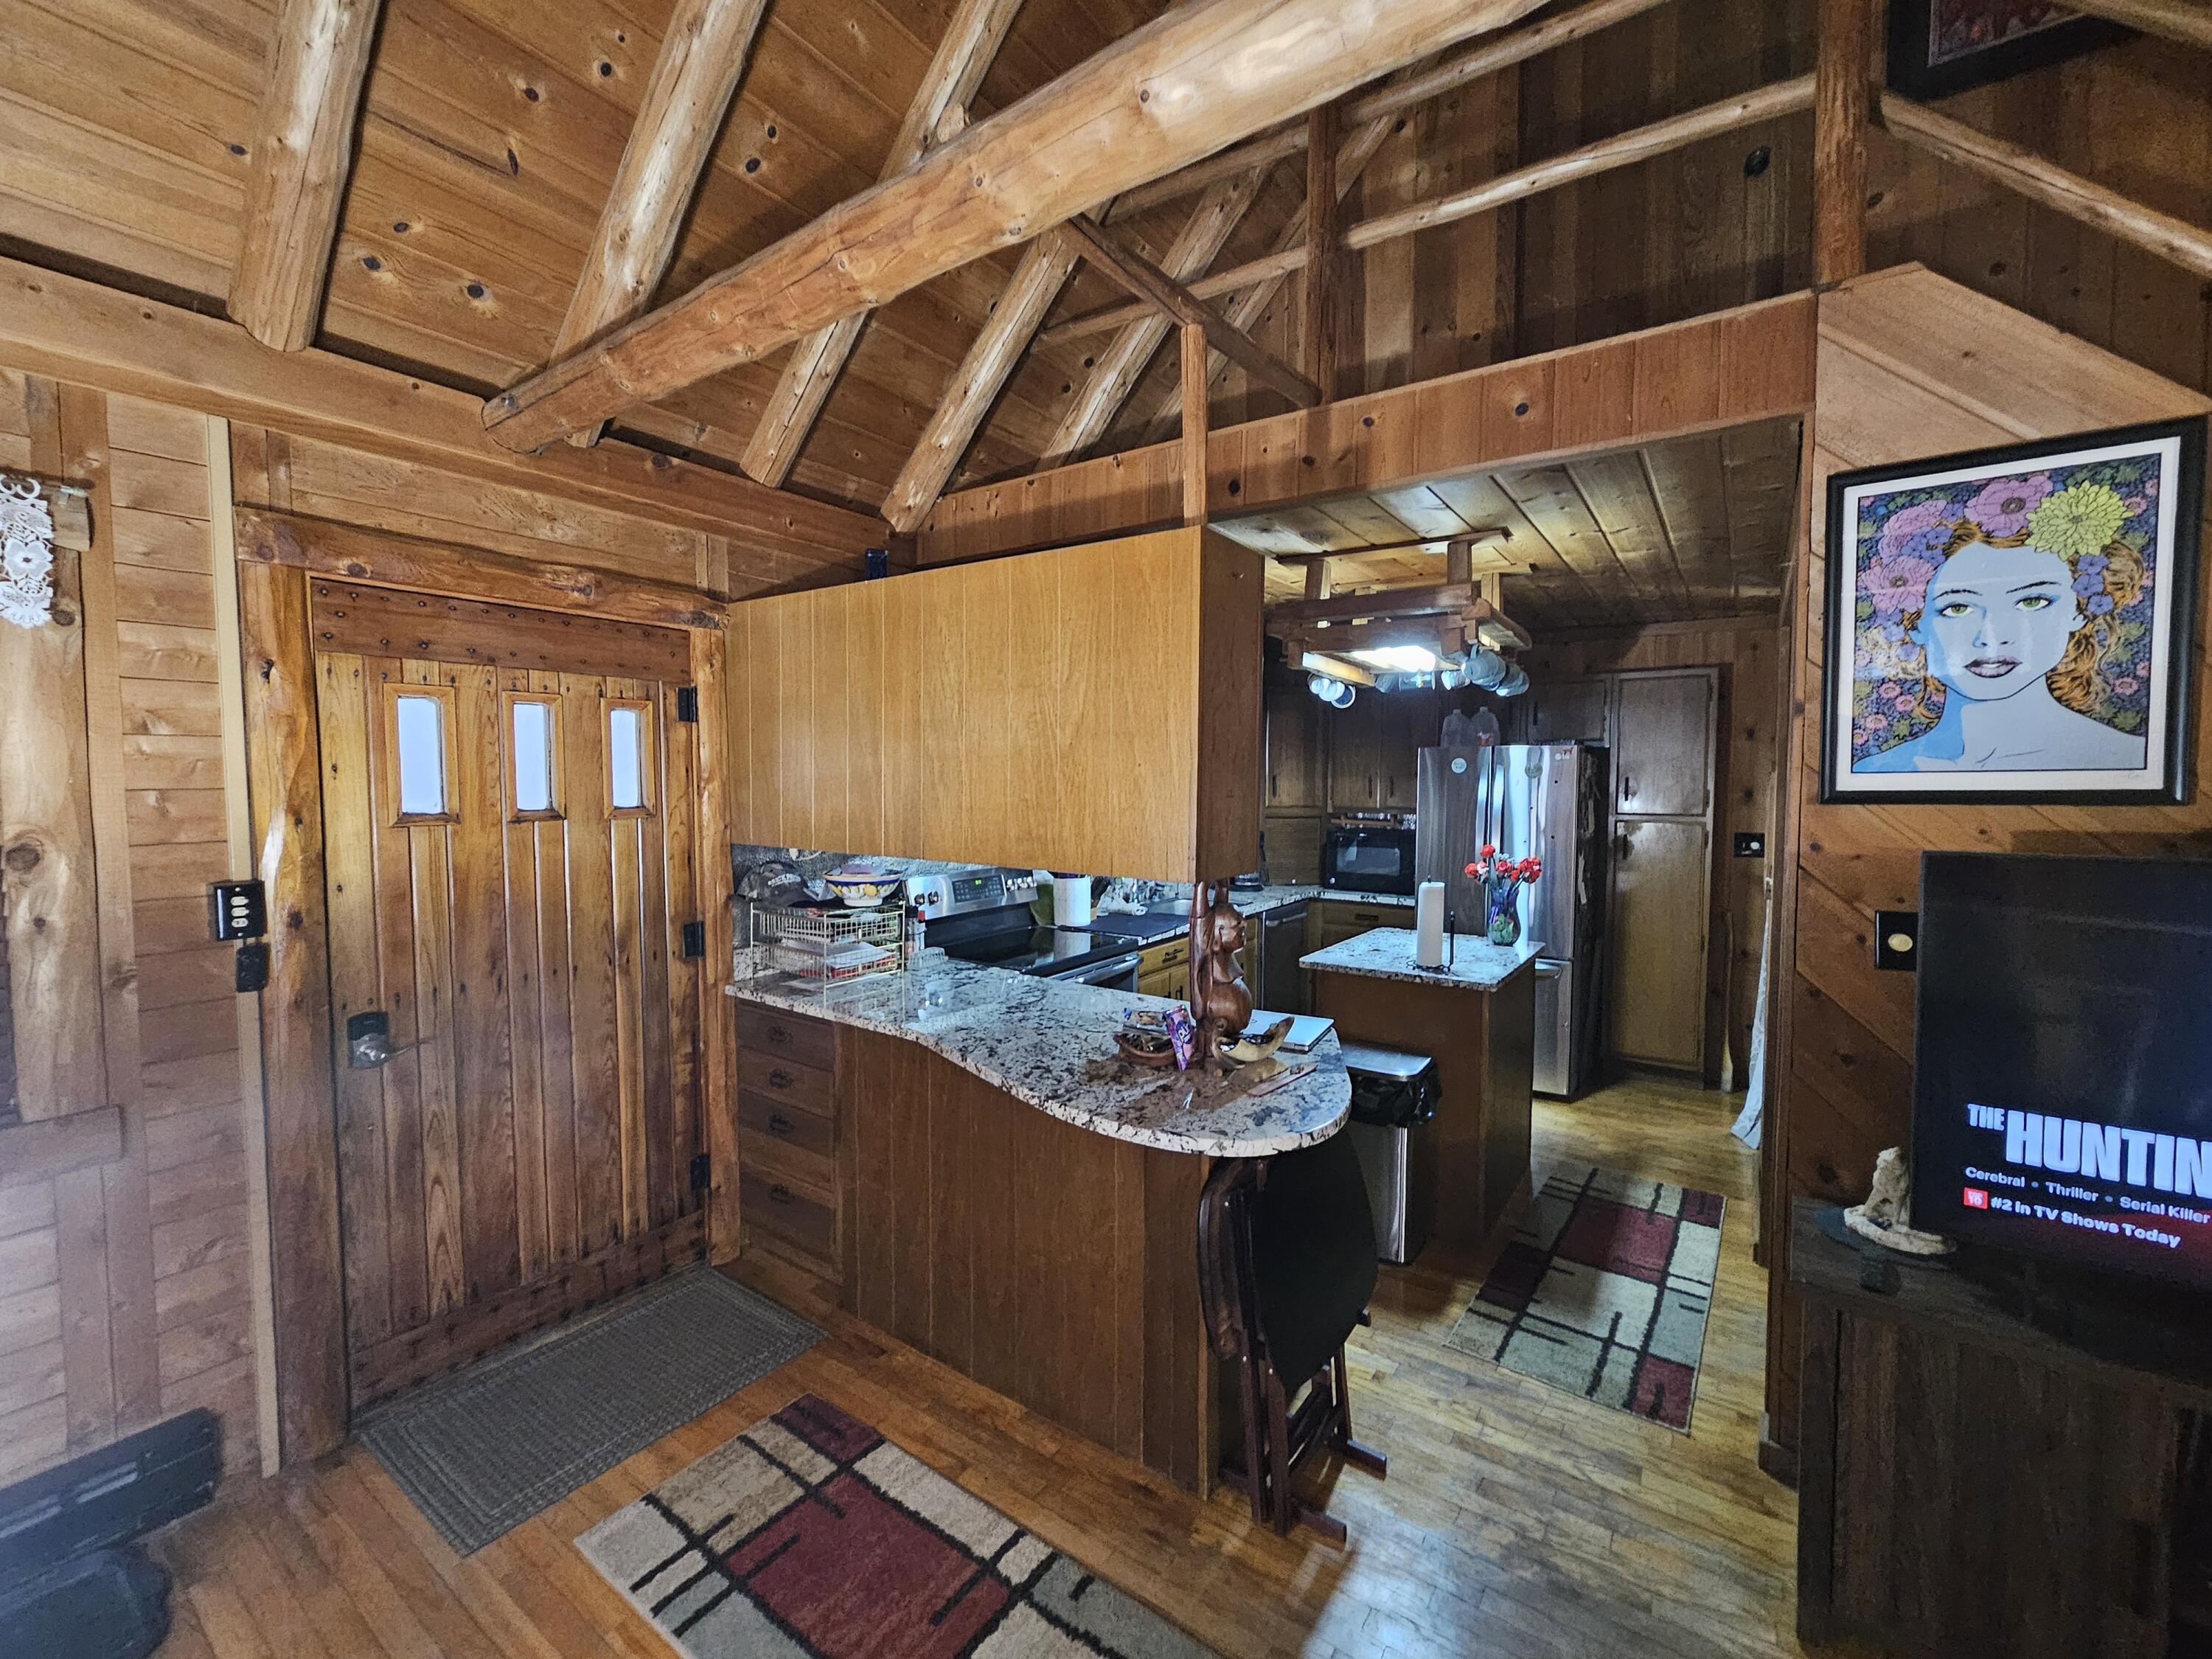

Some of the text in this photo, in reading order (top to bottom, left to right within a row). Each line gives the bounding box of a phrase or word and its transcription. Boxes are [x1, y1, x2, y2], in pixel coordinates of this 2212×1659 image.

[1966, 1103, 2212, 1200] THE HUNTIN
[1965, 1166, 2211, 1224] Cerebral Thriller Serial Killer
[1968, 1195, 1983, 1206] 10
[1990, 1197, 2181, 1248] #2 in TV Shows Today
